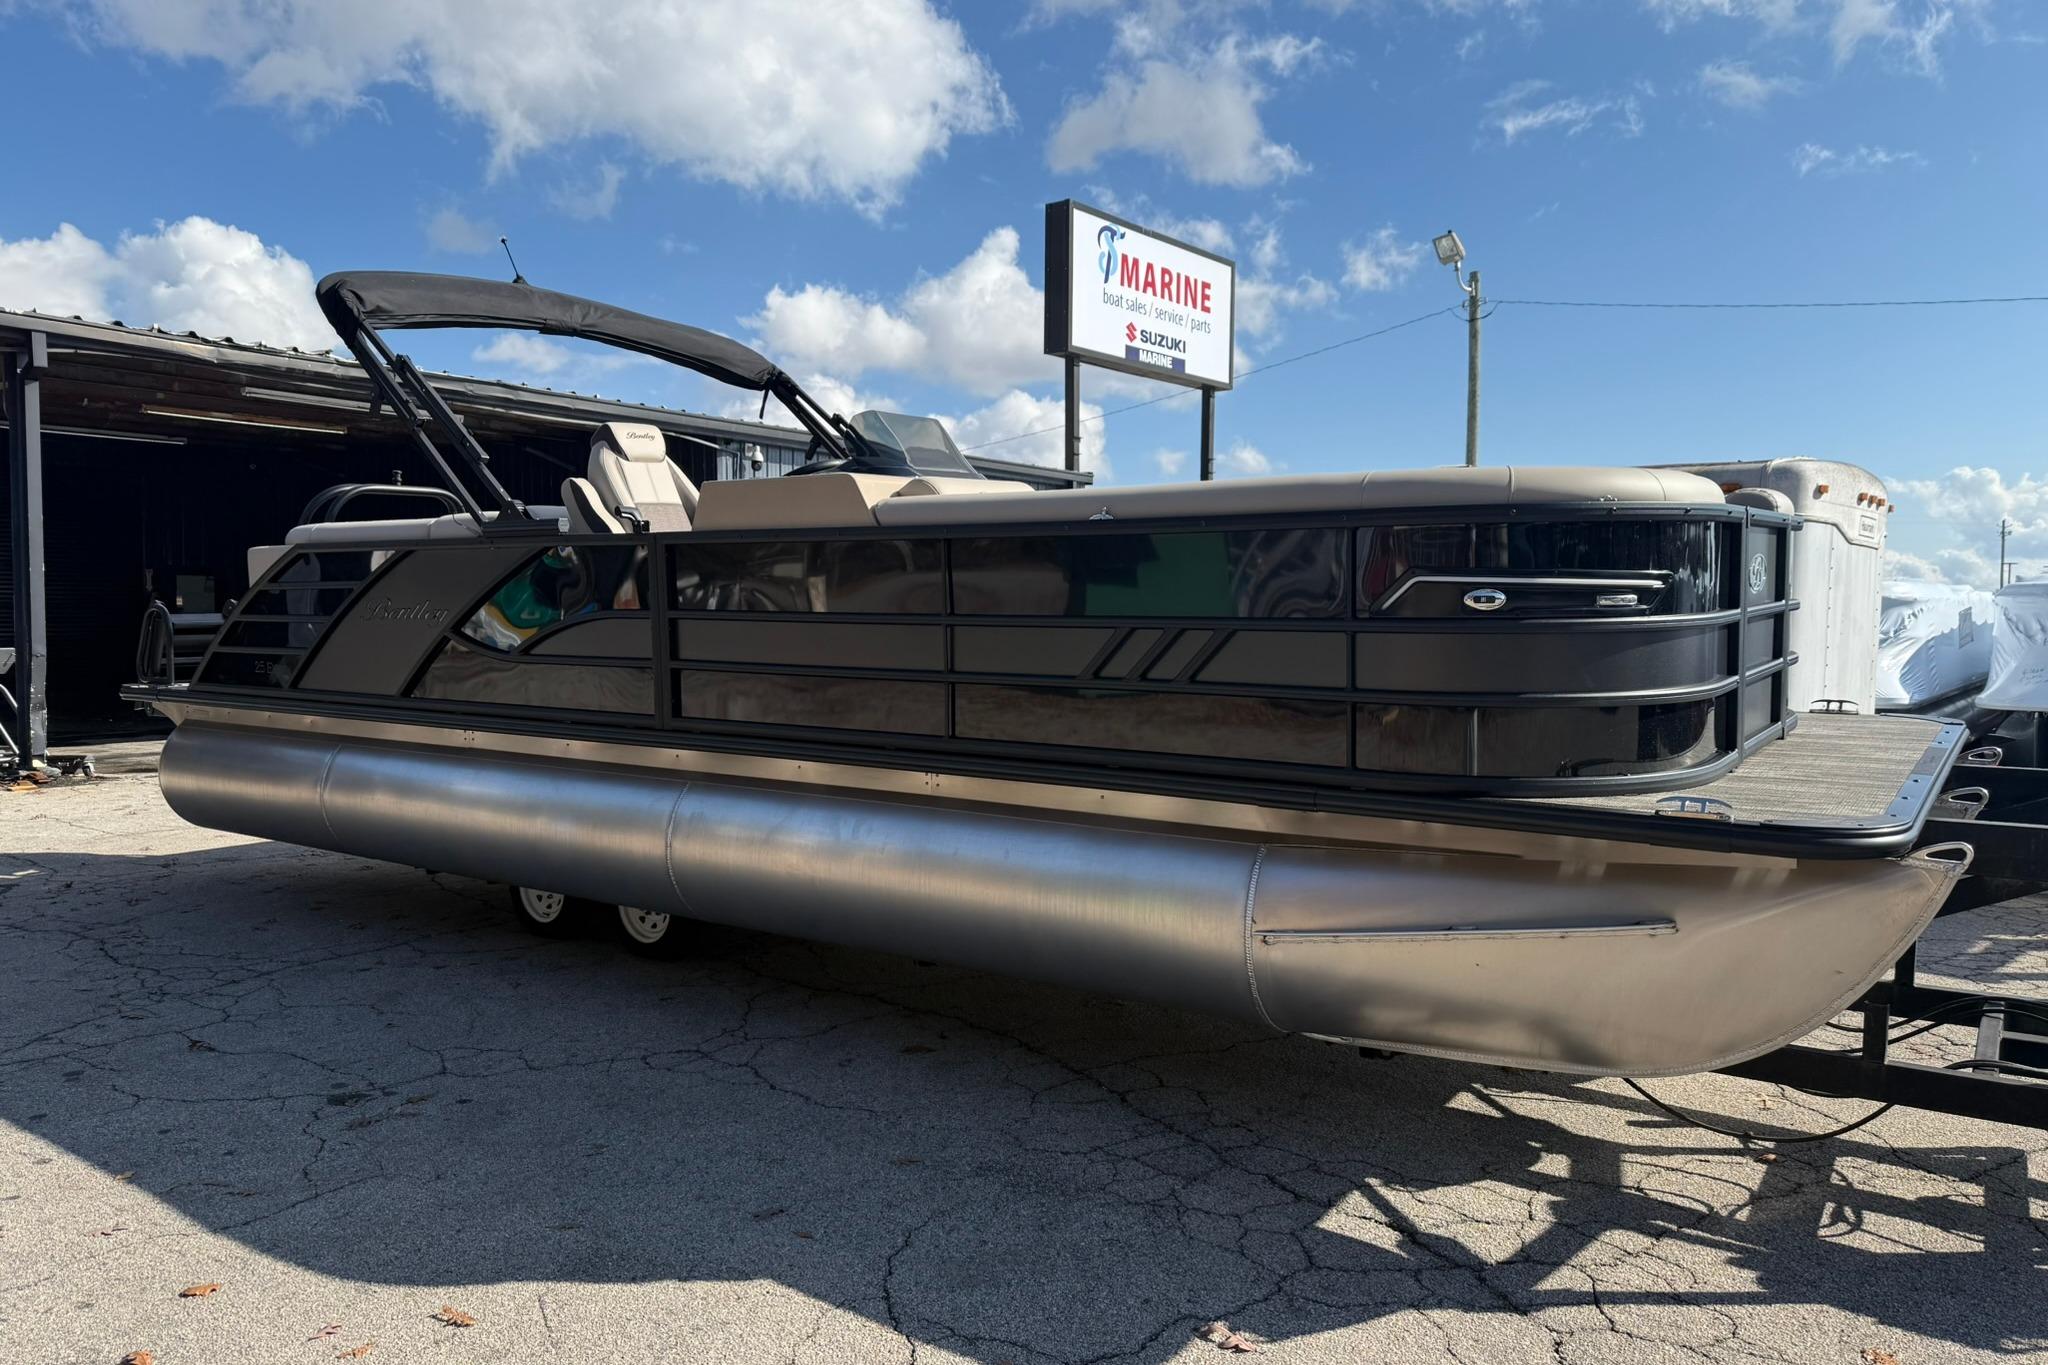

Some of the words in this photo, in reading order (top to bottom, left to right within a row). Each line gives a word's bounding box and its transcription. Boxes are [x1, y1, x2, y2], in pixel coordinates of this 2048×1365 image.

[1120, 253, 1212, 314] MARINE
[1103, 287, 1124, 309] boat
[1125, 297, 1147, 316] sales
[1155, 306, 1184, 326] service
[1190, 317, 1211, 334] parts
[1140, 329, 1186, 354] SUZUKI
[1139, 349, 1173, 369] MARINE
[626, 431, 655, 441] Bentley
[363, 597, 448, 624] Bentley
